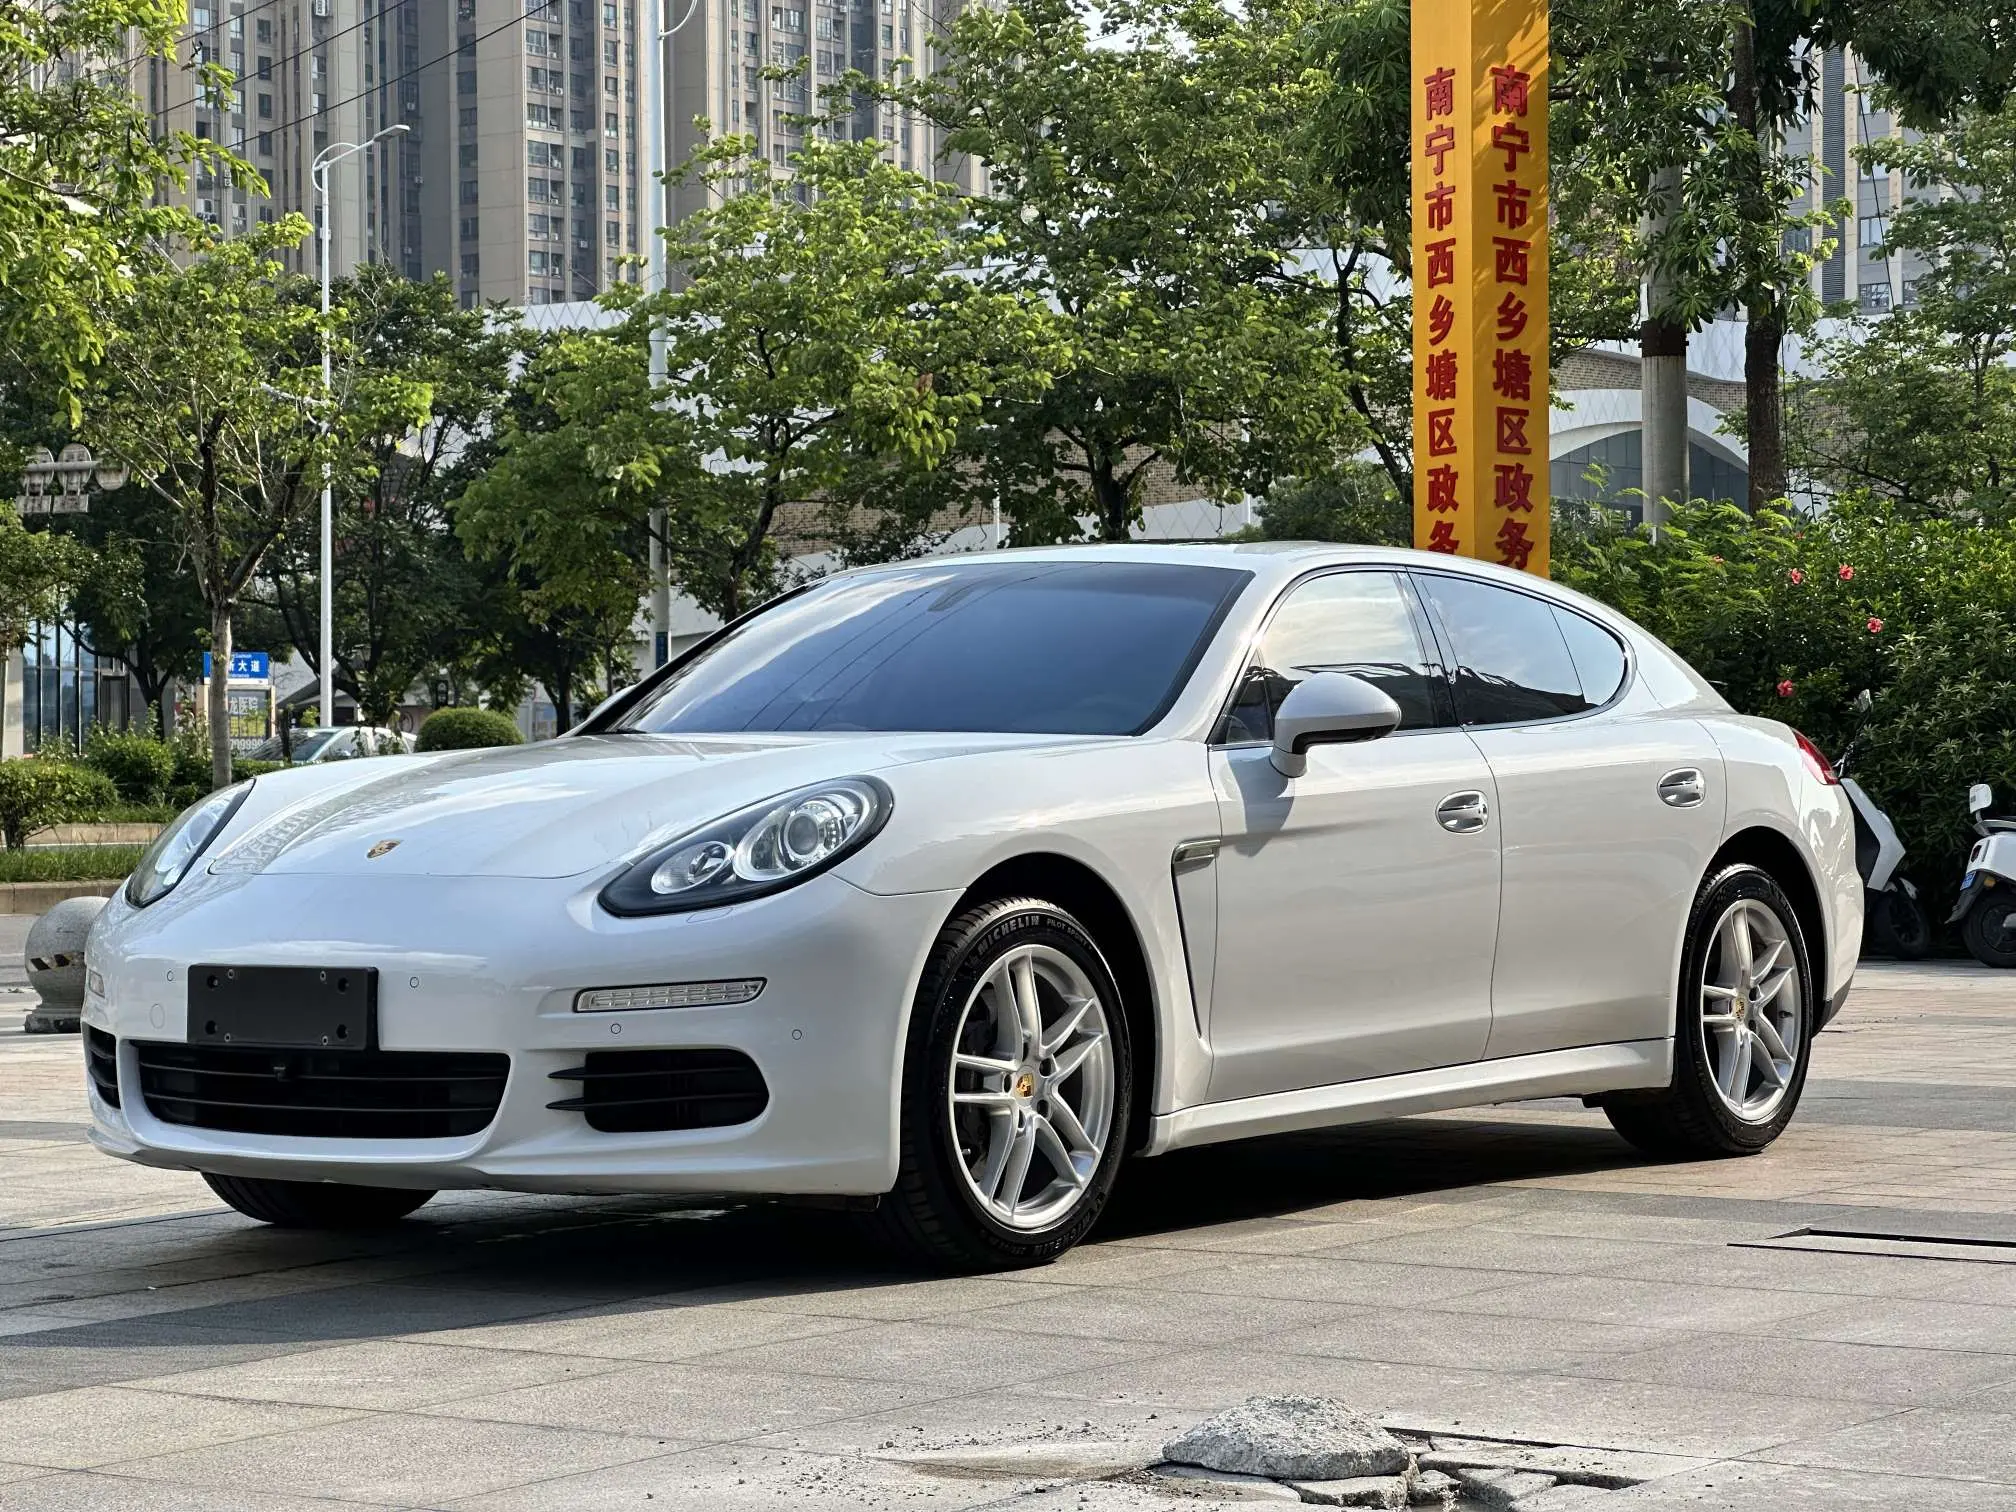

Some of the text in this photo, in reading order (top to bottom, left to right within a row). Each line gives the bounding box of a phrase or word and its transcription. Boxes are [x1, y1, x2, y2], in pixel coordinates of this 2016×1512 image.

[1423, 66, 1460, 555] 南宁市西乡塘区政务
[1490, 64, 1536, 570] 南宁市西乡塘区政务
[977, 915, 1041, 956] MICHELIN
